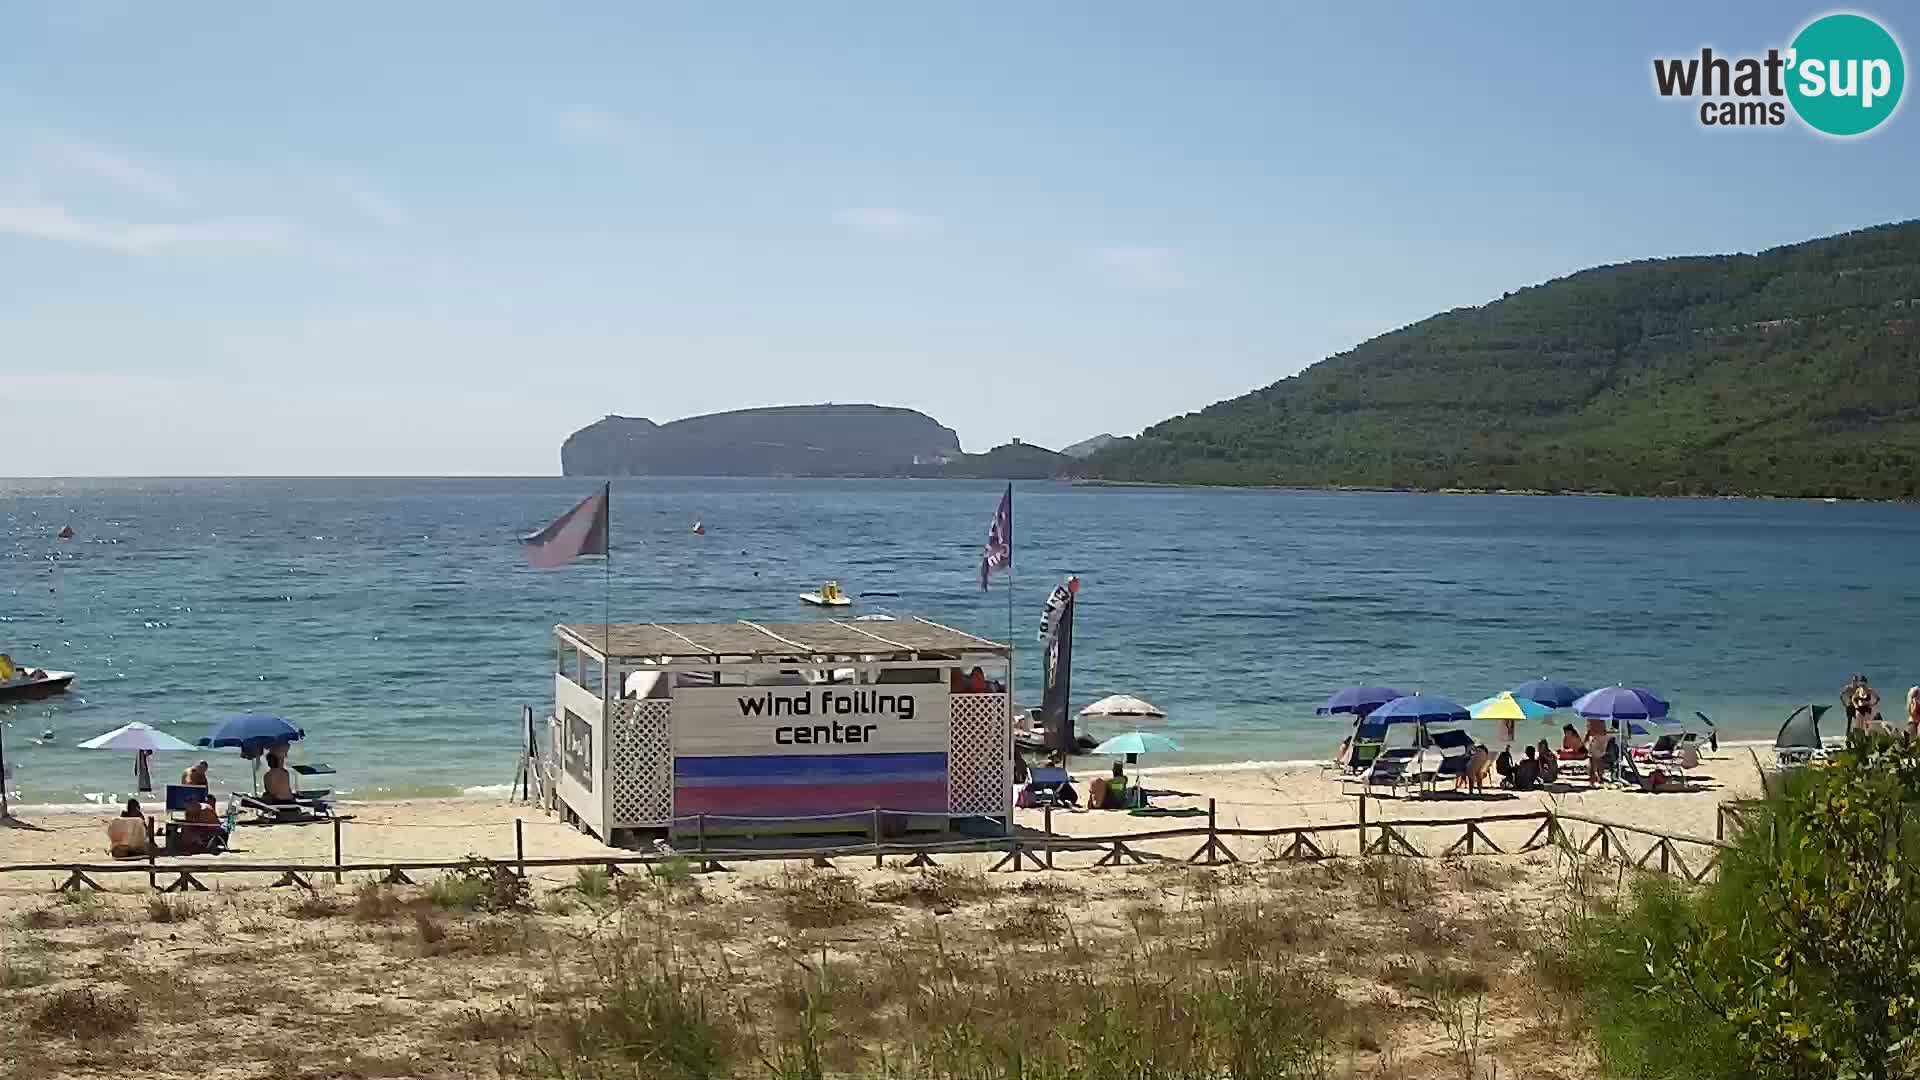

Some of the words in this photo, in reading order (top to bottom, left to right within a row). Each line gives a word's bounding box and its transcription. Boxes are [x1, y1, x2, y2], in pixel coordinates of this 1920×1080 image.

[738, 692, 811, 716] wind
[821, 691, 915, 720] foiling
[775, 722, 877, 745] center
